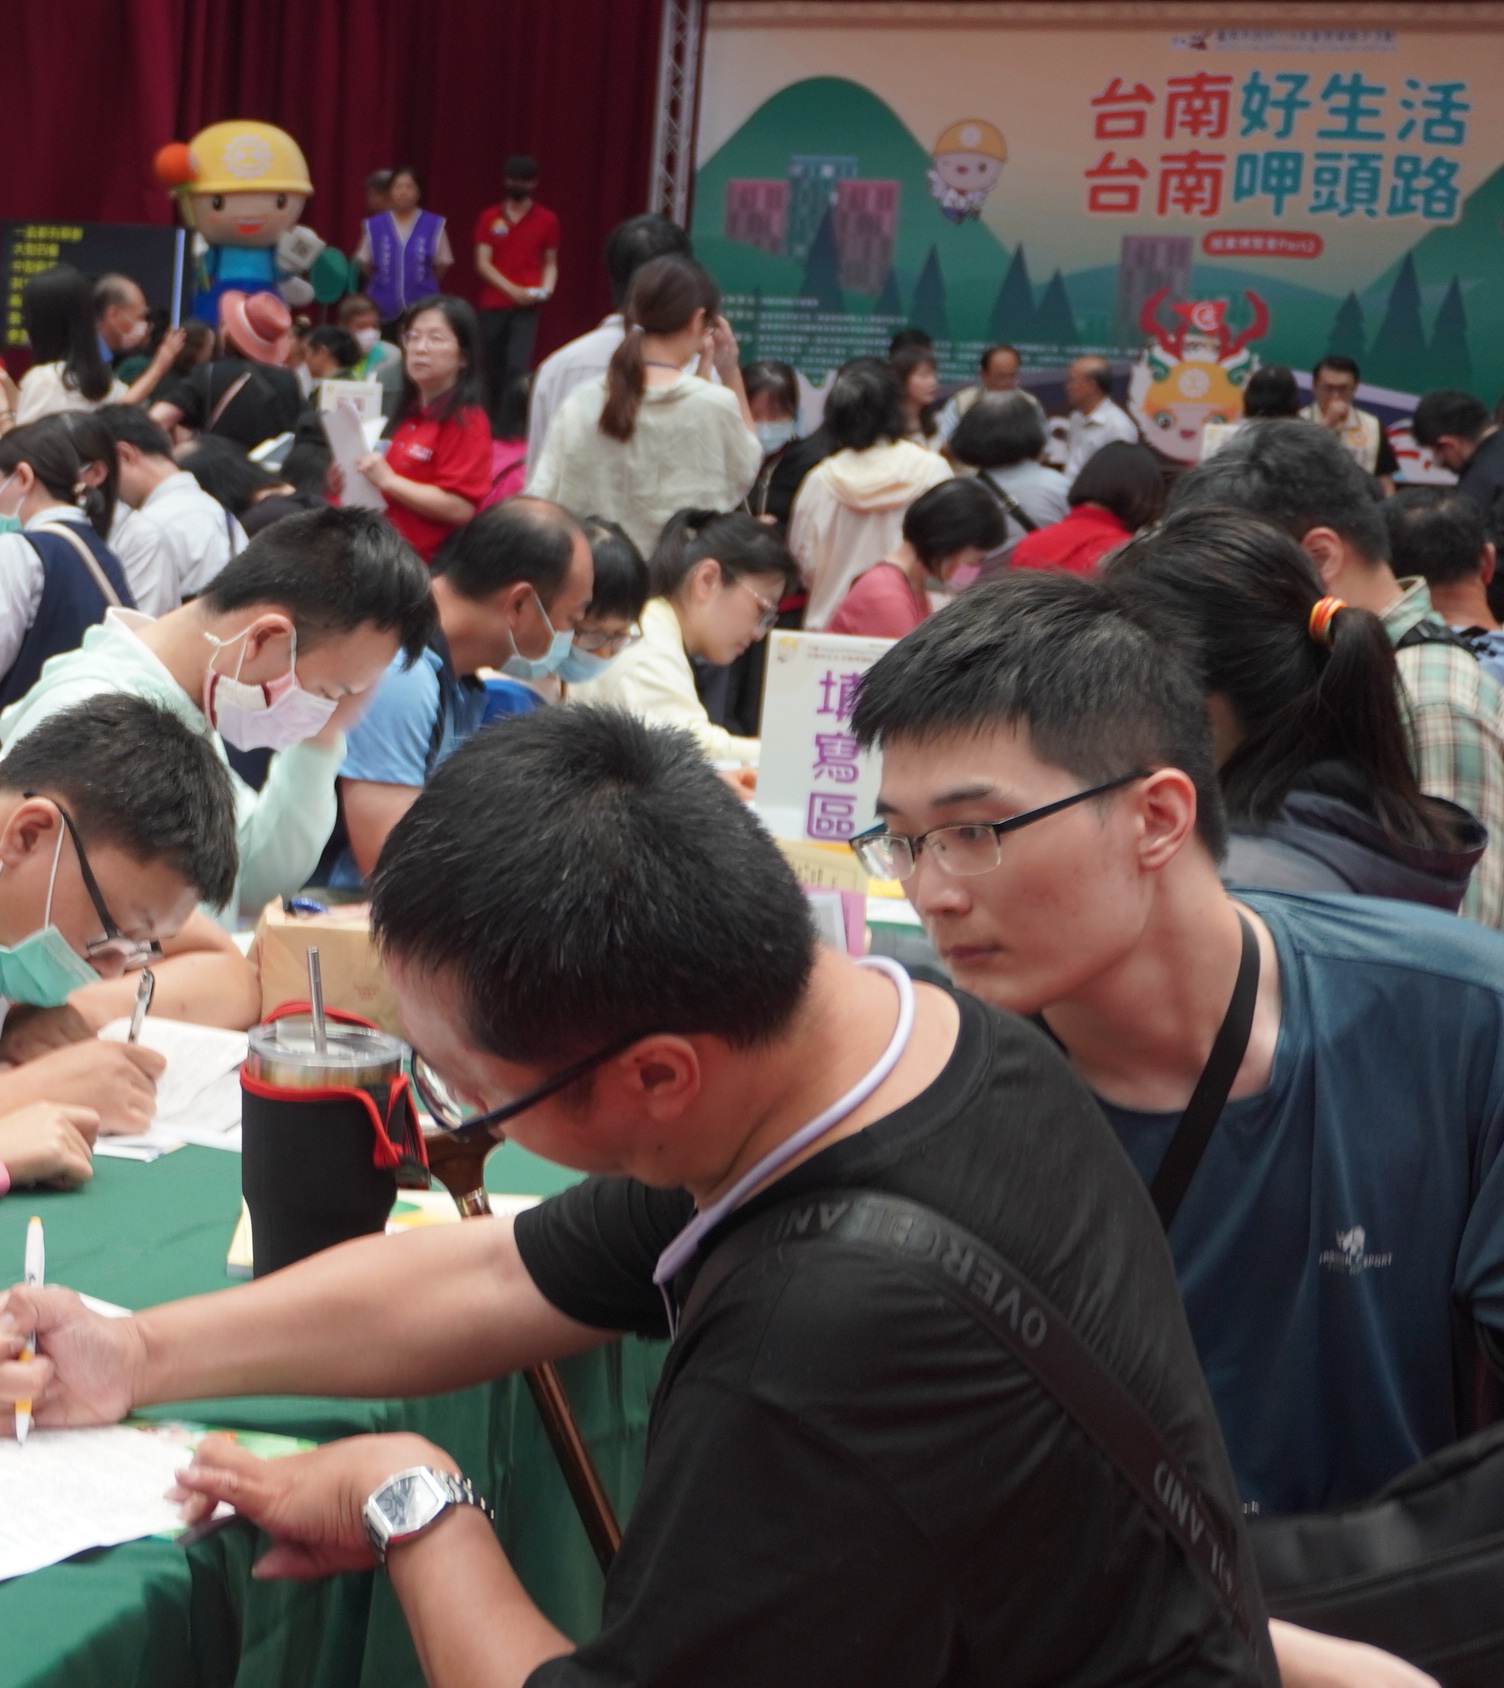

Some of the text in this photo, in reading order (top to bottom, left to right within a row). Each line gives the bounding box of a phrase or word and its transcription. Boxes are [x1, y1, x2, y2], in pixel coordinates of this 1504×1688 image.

[1090, 71, 1472, 147] 台南好生活
[1084, 149, 1462, 220] 台南呷頭路
